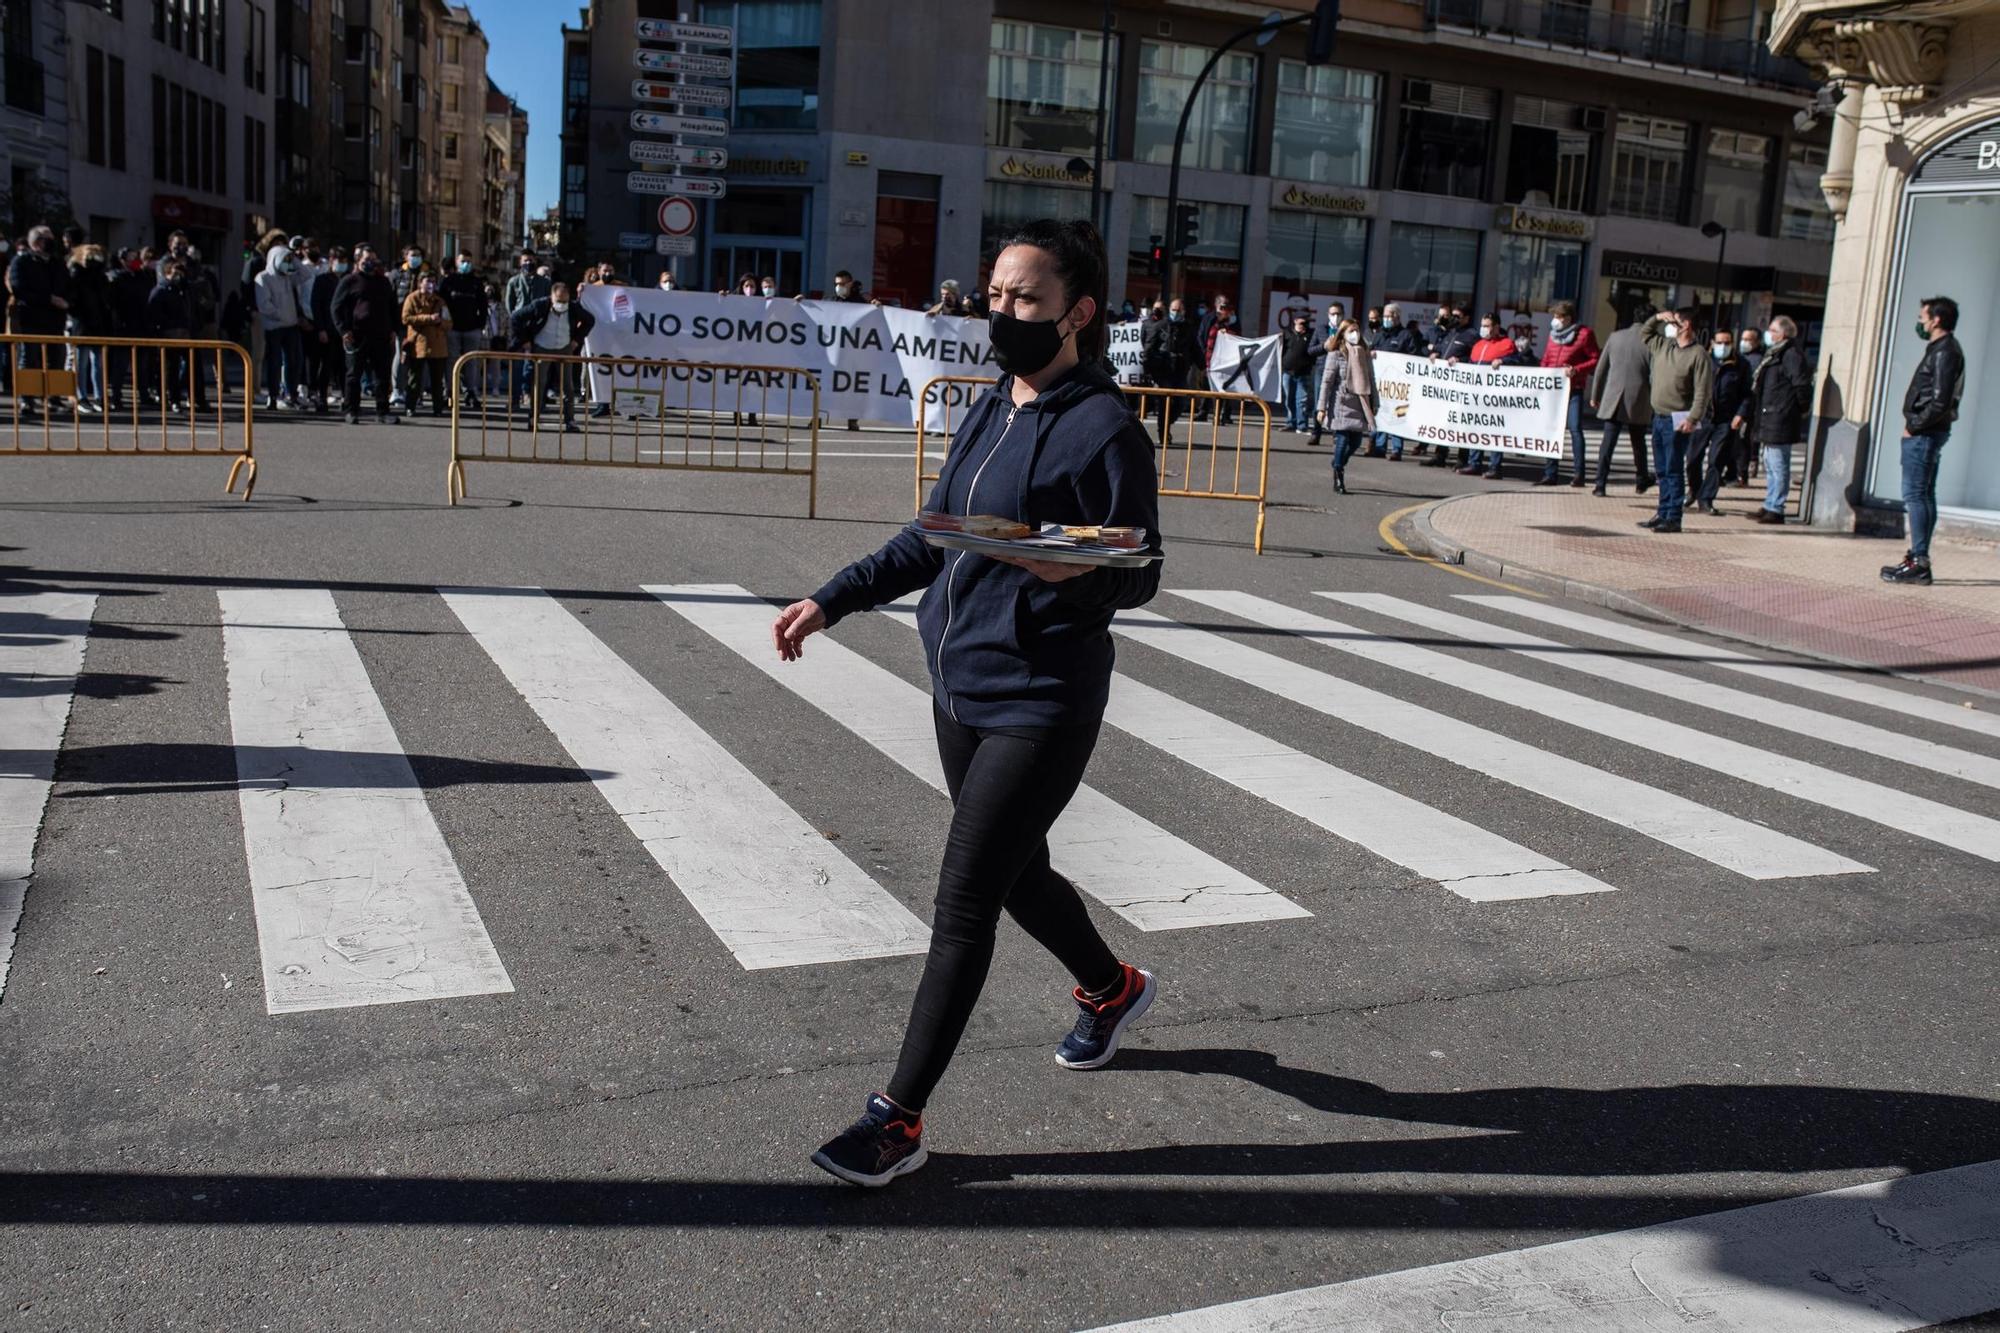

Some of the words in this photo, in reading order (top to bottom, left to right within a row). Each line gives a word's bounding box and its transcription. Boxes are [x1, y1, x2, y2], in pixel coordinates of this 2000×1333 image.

[677, 29, 729, 40] SALAMANCA
[680, 64, 728, 73] VALLADOLID
[680, 122, 724, 133] Hospitales
[1978, 141, 2000, 170] B
[632, 183, 666, 191] ORENSE
[1302, 190, 1365, 211] Santander
[634, 312, 681, 337] NO
[693, 316, 807, 345] SOMOS
[817, 324, 882, 351] UNA
[596, 353, 712, 384] SOMOS
[724, 366, 822, 393] PARTE
[833, 370, 870, 394] DE
[880, 373, 914, 400] LA
[1405, 362, 1415, 375] SI
[1418, 364, 1429, 377] LA
[1487, 373, 1562, 390] DESAPARECE
[1378, 379, 1411, 402] AHOSBE
[1422, 385, 1469, 405] BENAVENTE
[1473, 393, 1480, 406] Y
[1483, 394, 1540, 410] COMARCA
[1447, 410, 1458, 423] SE
[1461, 412, 1505, 427] APAGAN
[1417, 425, 1560, 454] #SOSHOSTELERIA
